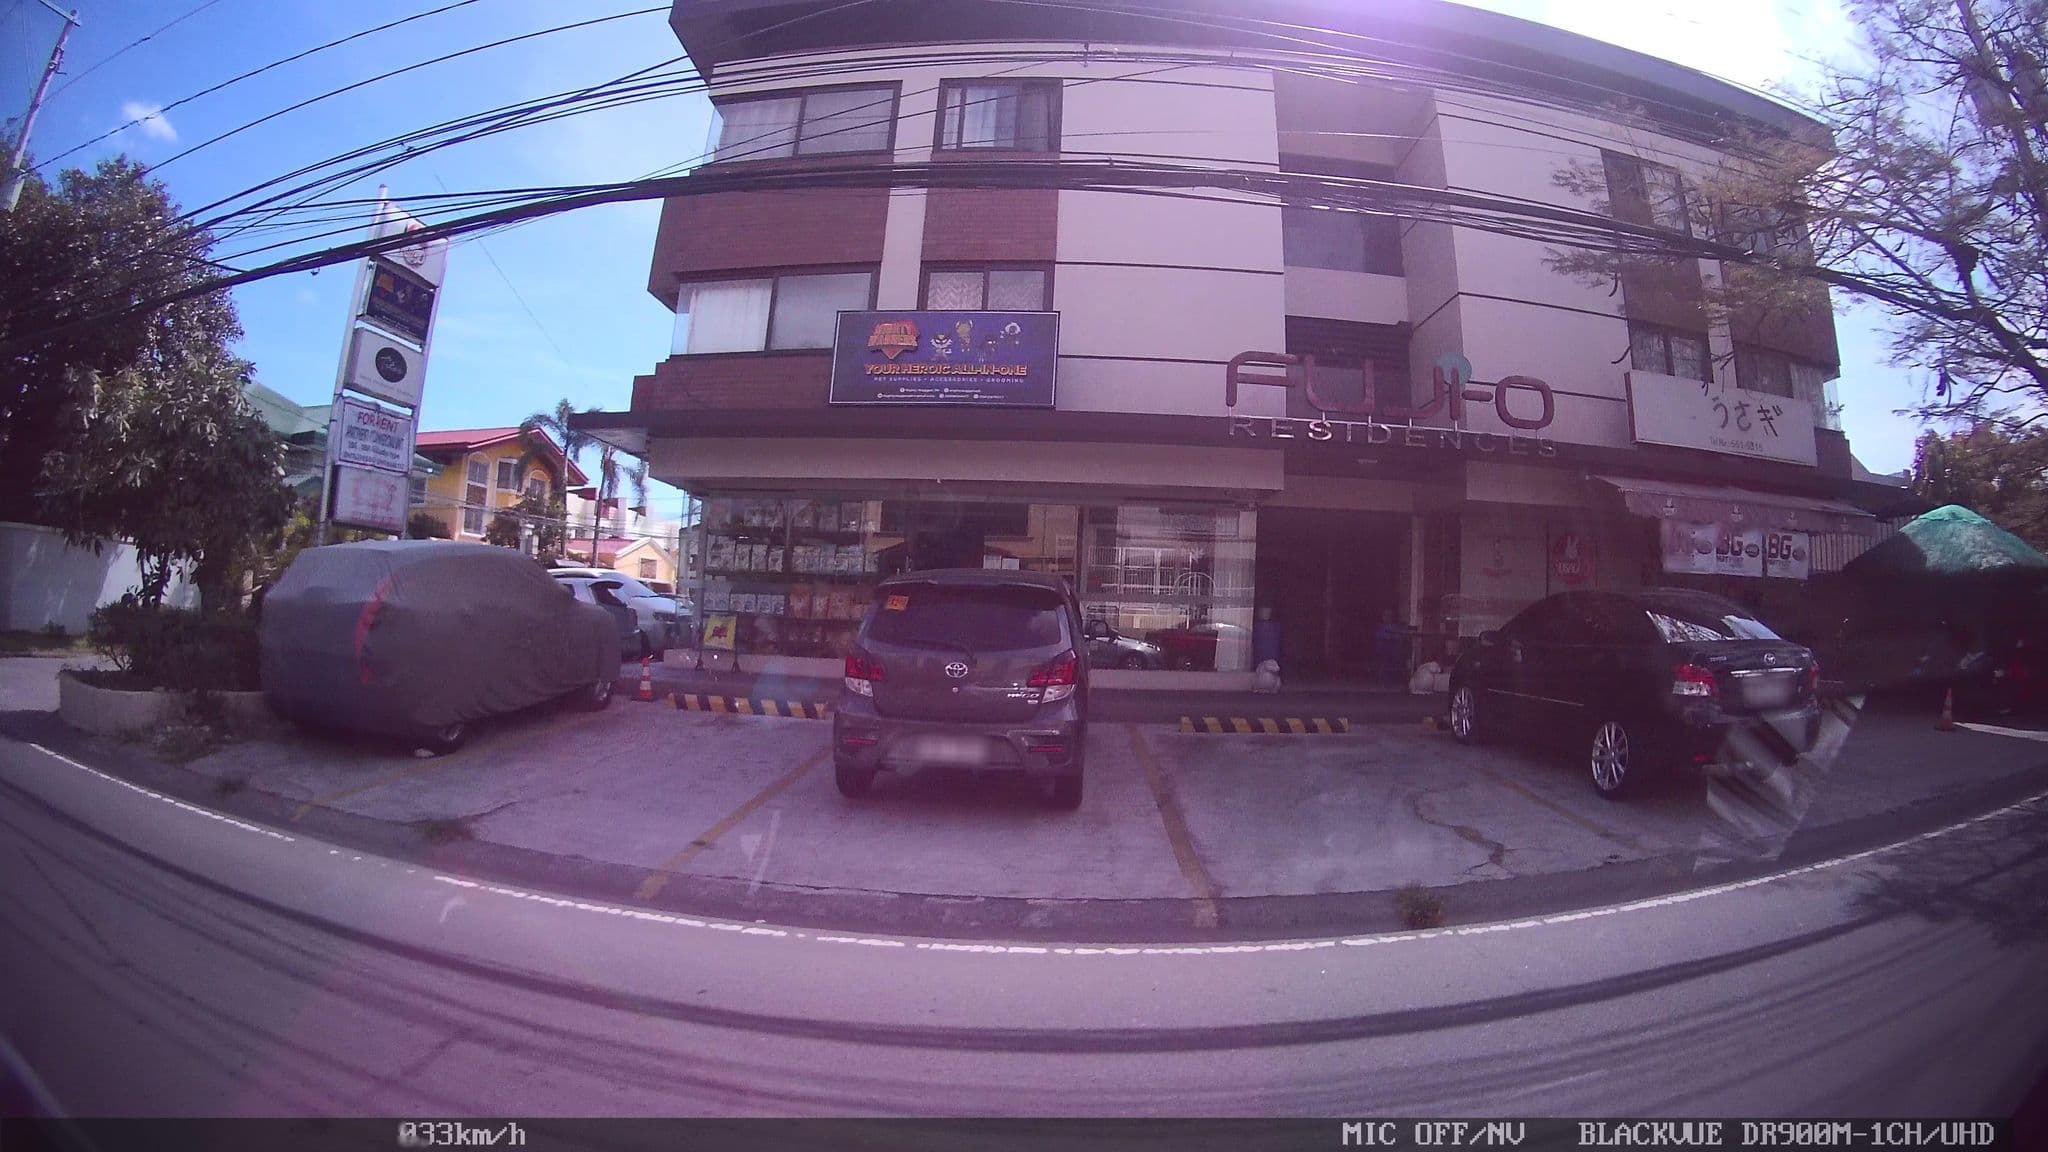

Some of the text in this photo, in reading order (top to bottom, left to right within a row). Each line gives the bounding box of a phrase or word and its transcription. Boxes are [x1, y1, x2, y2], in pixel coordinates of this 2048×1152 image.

[865, 363, 1027, 376] YOUR HEROIC ALL-IN-ONE
[1226, 350, 1554, 429] FUJI-O
[357, 411, 376, 427] FOR
[1712, 396, 1783, 437] うさぎ
[1229, 418, 1557, 457] RESIDENCES
[1768, 533, 1793, 560] BG
